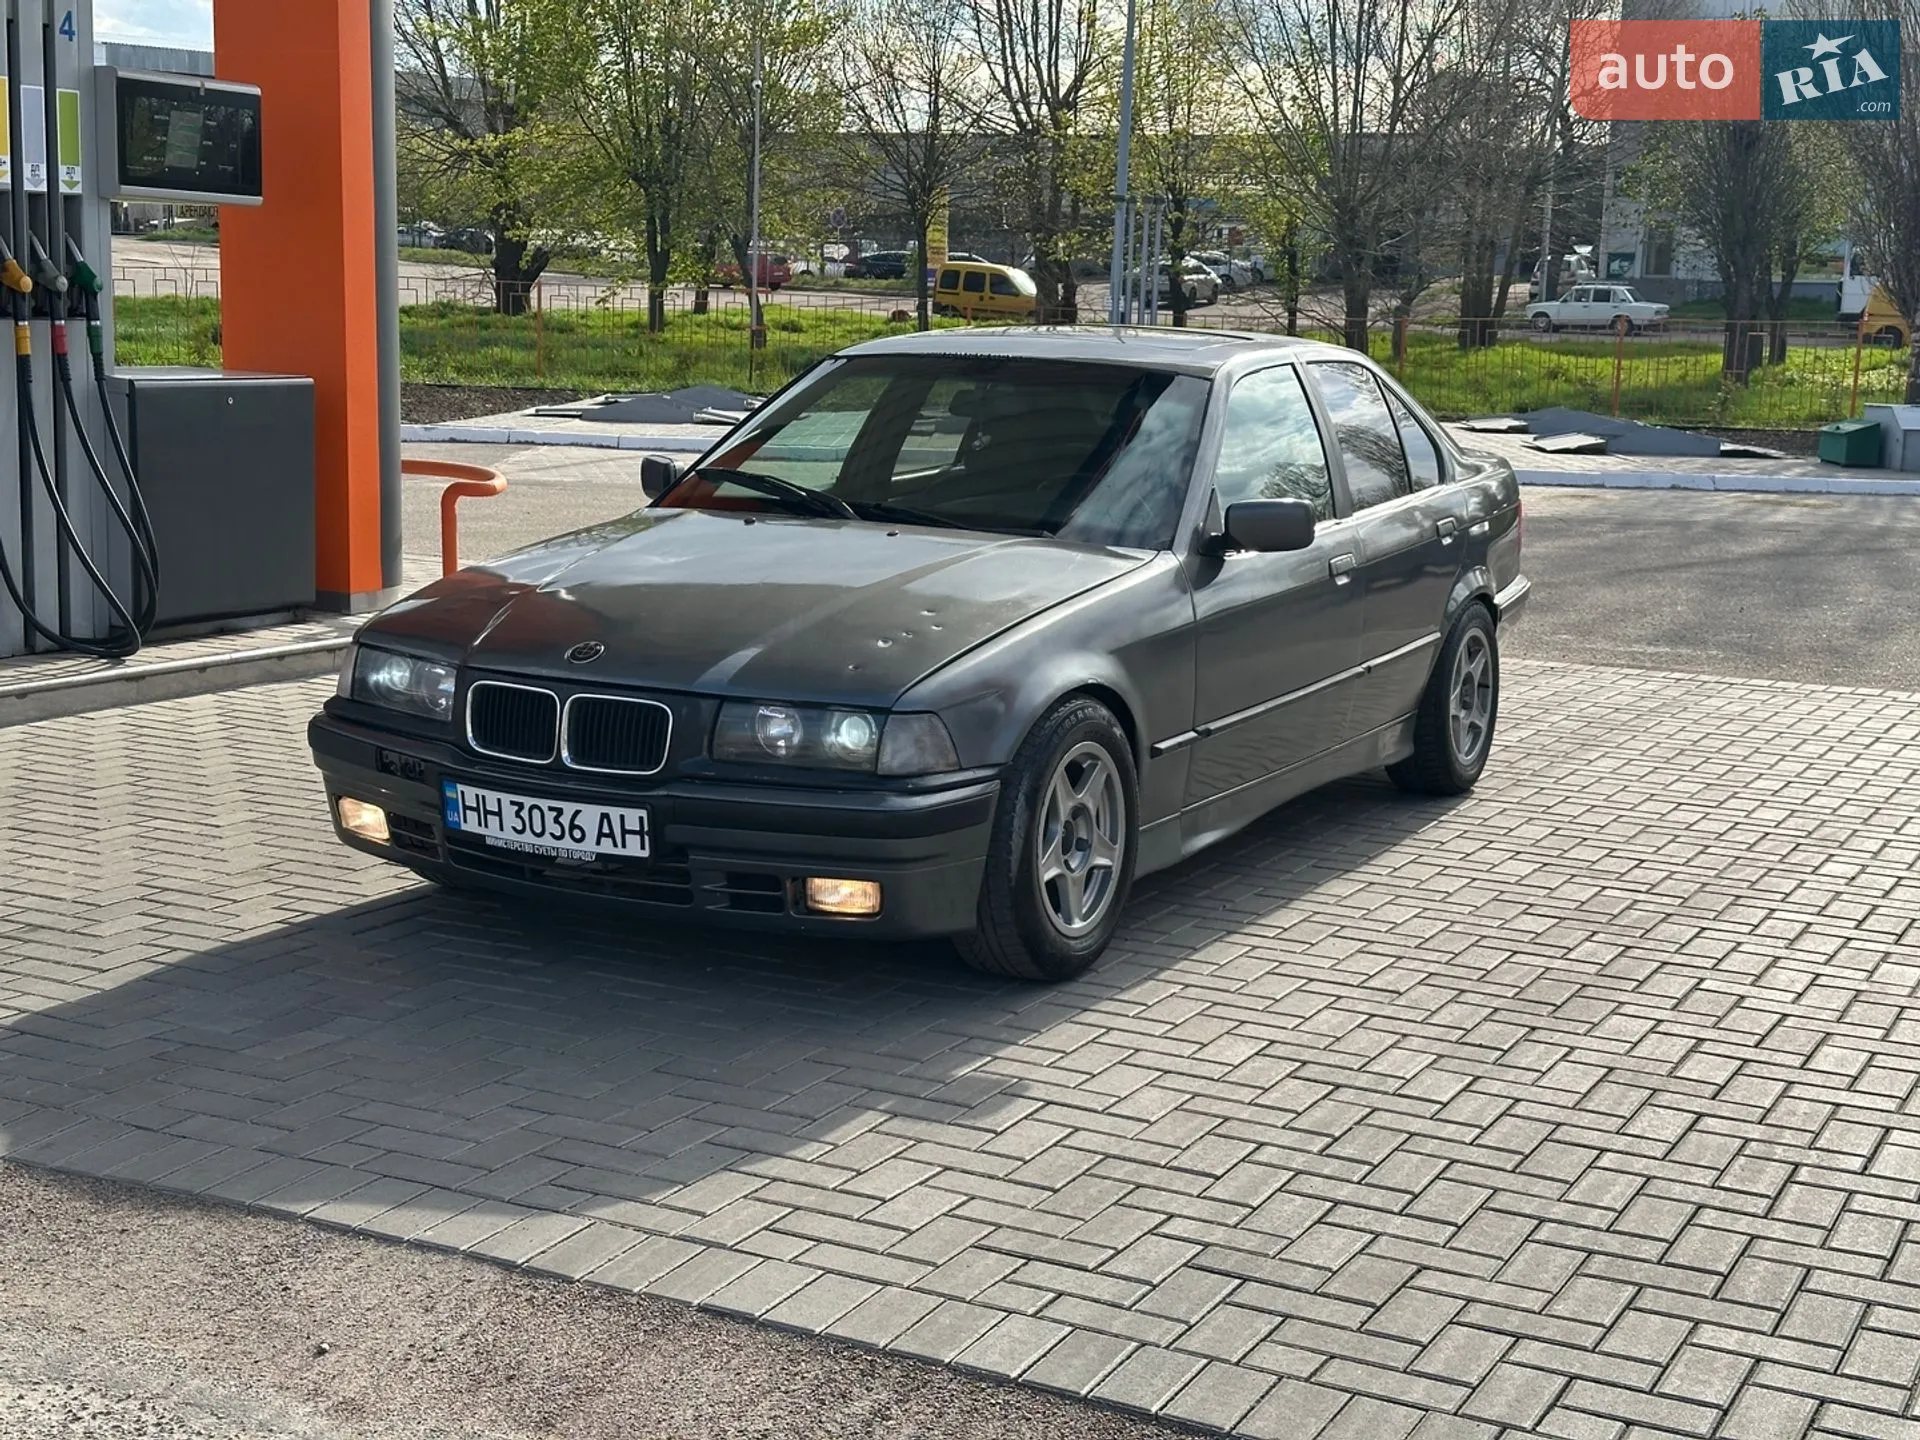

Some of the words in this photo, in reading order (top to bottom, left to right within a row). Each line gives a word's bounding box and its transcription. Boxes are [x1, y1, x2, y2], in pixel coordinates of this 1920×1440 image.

[59, 11, 76, 42] 4
[447, 811, 459, 823] UA
[460, 789, 504, 832] HH
[509, 799, 587, 844] 3036
[594, 811, 646, 851] AH
[534, 845, 557, 857] СУЕТЫ
[568, 850, 597, 862] ГОРОДУ
